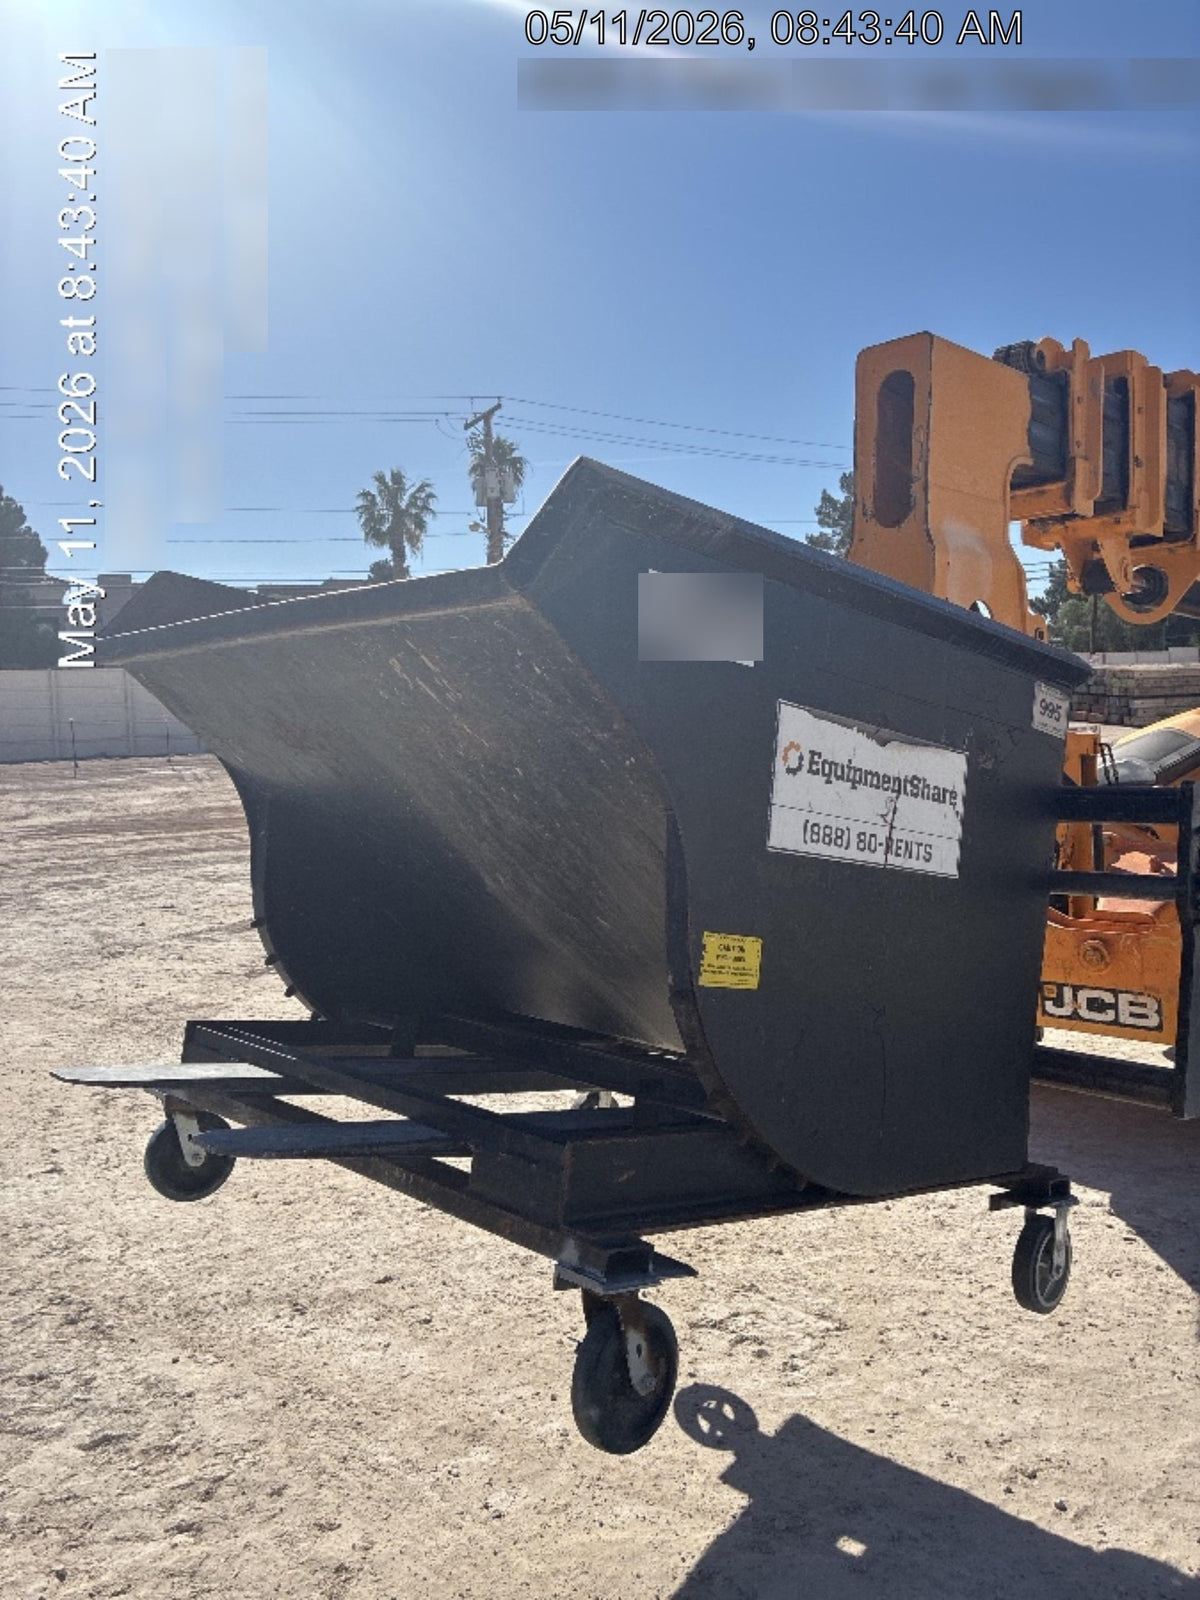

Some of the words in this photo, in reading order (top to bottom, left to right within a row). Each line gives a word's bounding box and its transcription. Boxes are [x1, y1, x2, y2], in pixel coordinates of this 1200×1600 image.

[807, 750, 958, 806] EquipmentShare
[803, 819, 850, 850] (888)
[1045, 986, 1160, 1027] JCB
